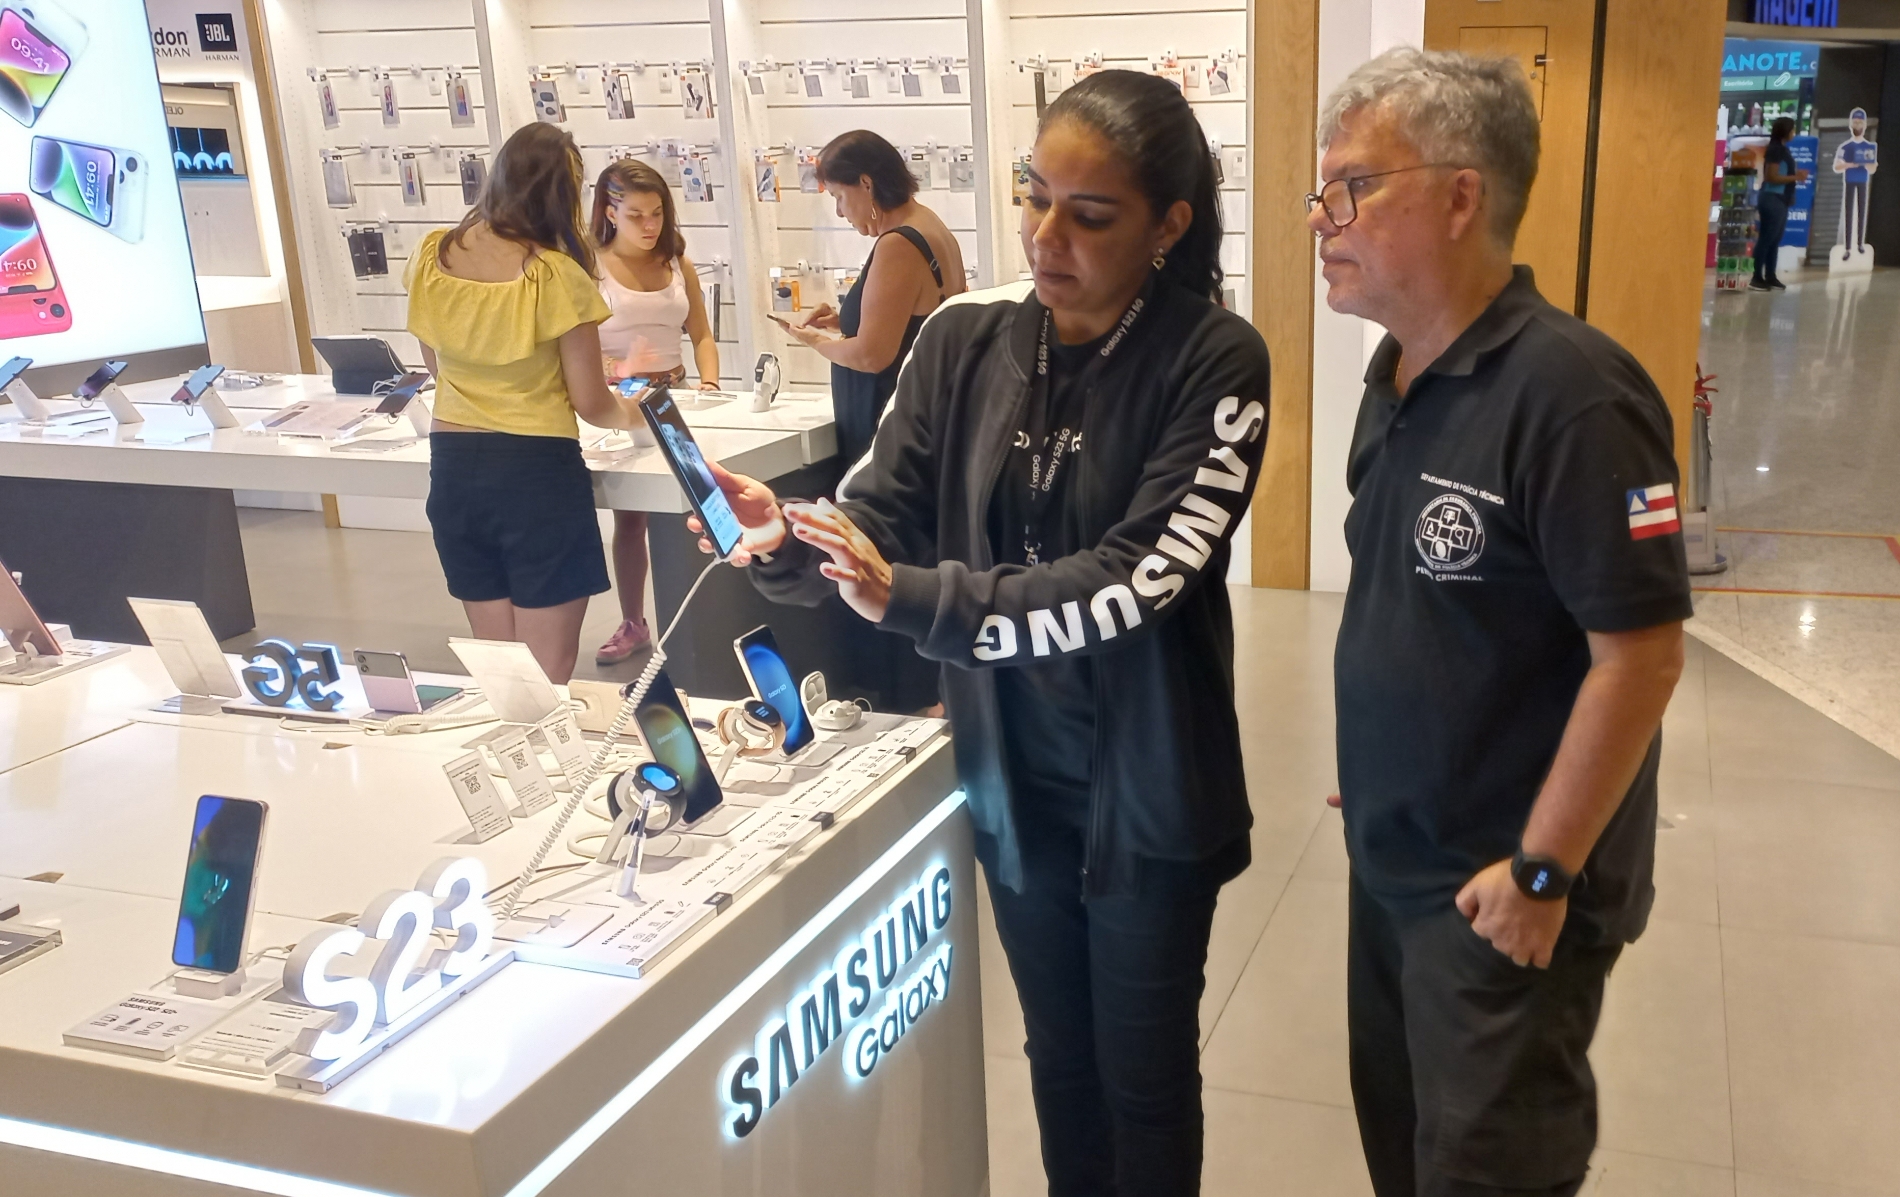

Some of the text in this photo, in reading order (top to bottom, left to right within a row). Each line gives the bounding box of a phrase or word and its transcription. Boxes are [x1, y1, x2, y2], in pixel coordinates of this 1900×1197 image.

[151, 26, 188, 46] don
[154, 47, 191, 58] RMAN
[205, 23, 231, 42] JBL
[10, 36, 50, 74] 09:41
[84, 160, 98, 207] 09:41
[1100, 325, 1128, 357] Galaxy
[1121, 309, 1137, 328] S23
[1029, 454, 1041, 490] Galaxy
[1041, 427, 1071, 492] Galaxy S23 5G
[1420, 472, 1505, 506] DEPARTAMENTO DE POLÍCIA TÉCNICA
[972, 395, 1265, 661] SAMSUNG
[1435, 573, 1484, 582] CRIMINAL
[284, 857, 492, 1061] S23
[725, 866, 951, 1138] SAMSUNG
[854, 945, 953, 1078] Galaxy
